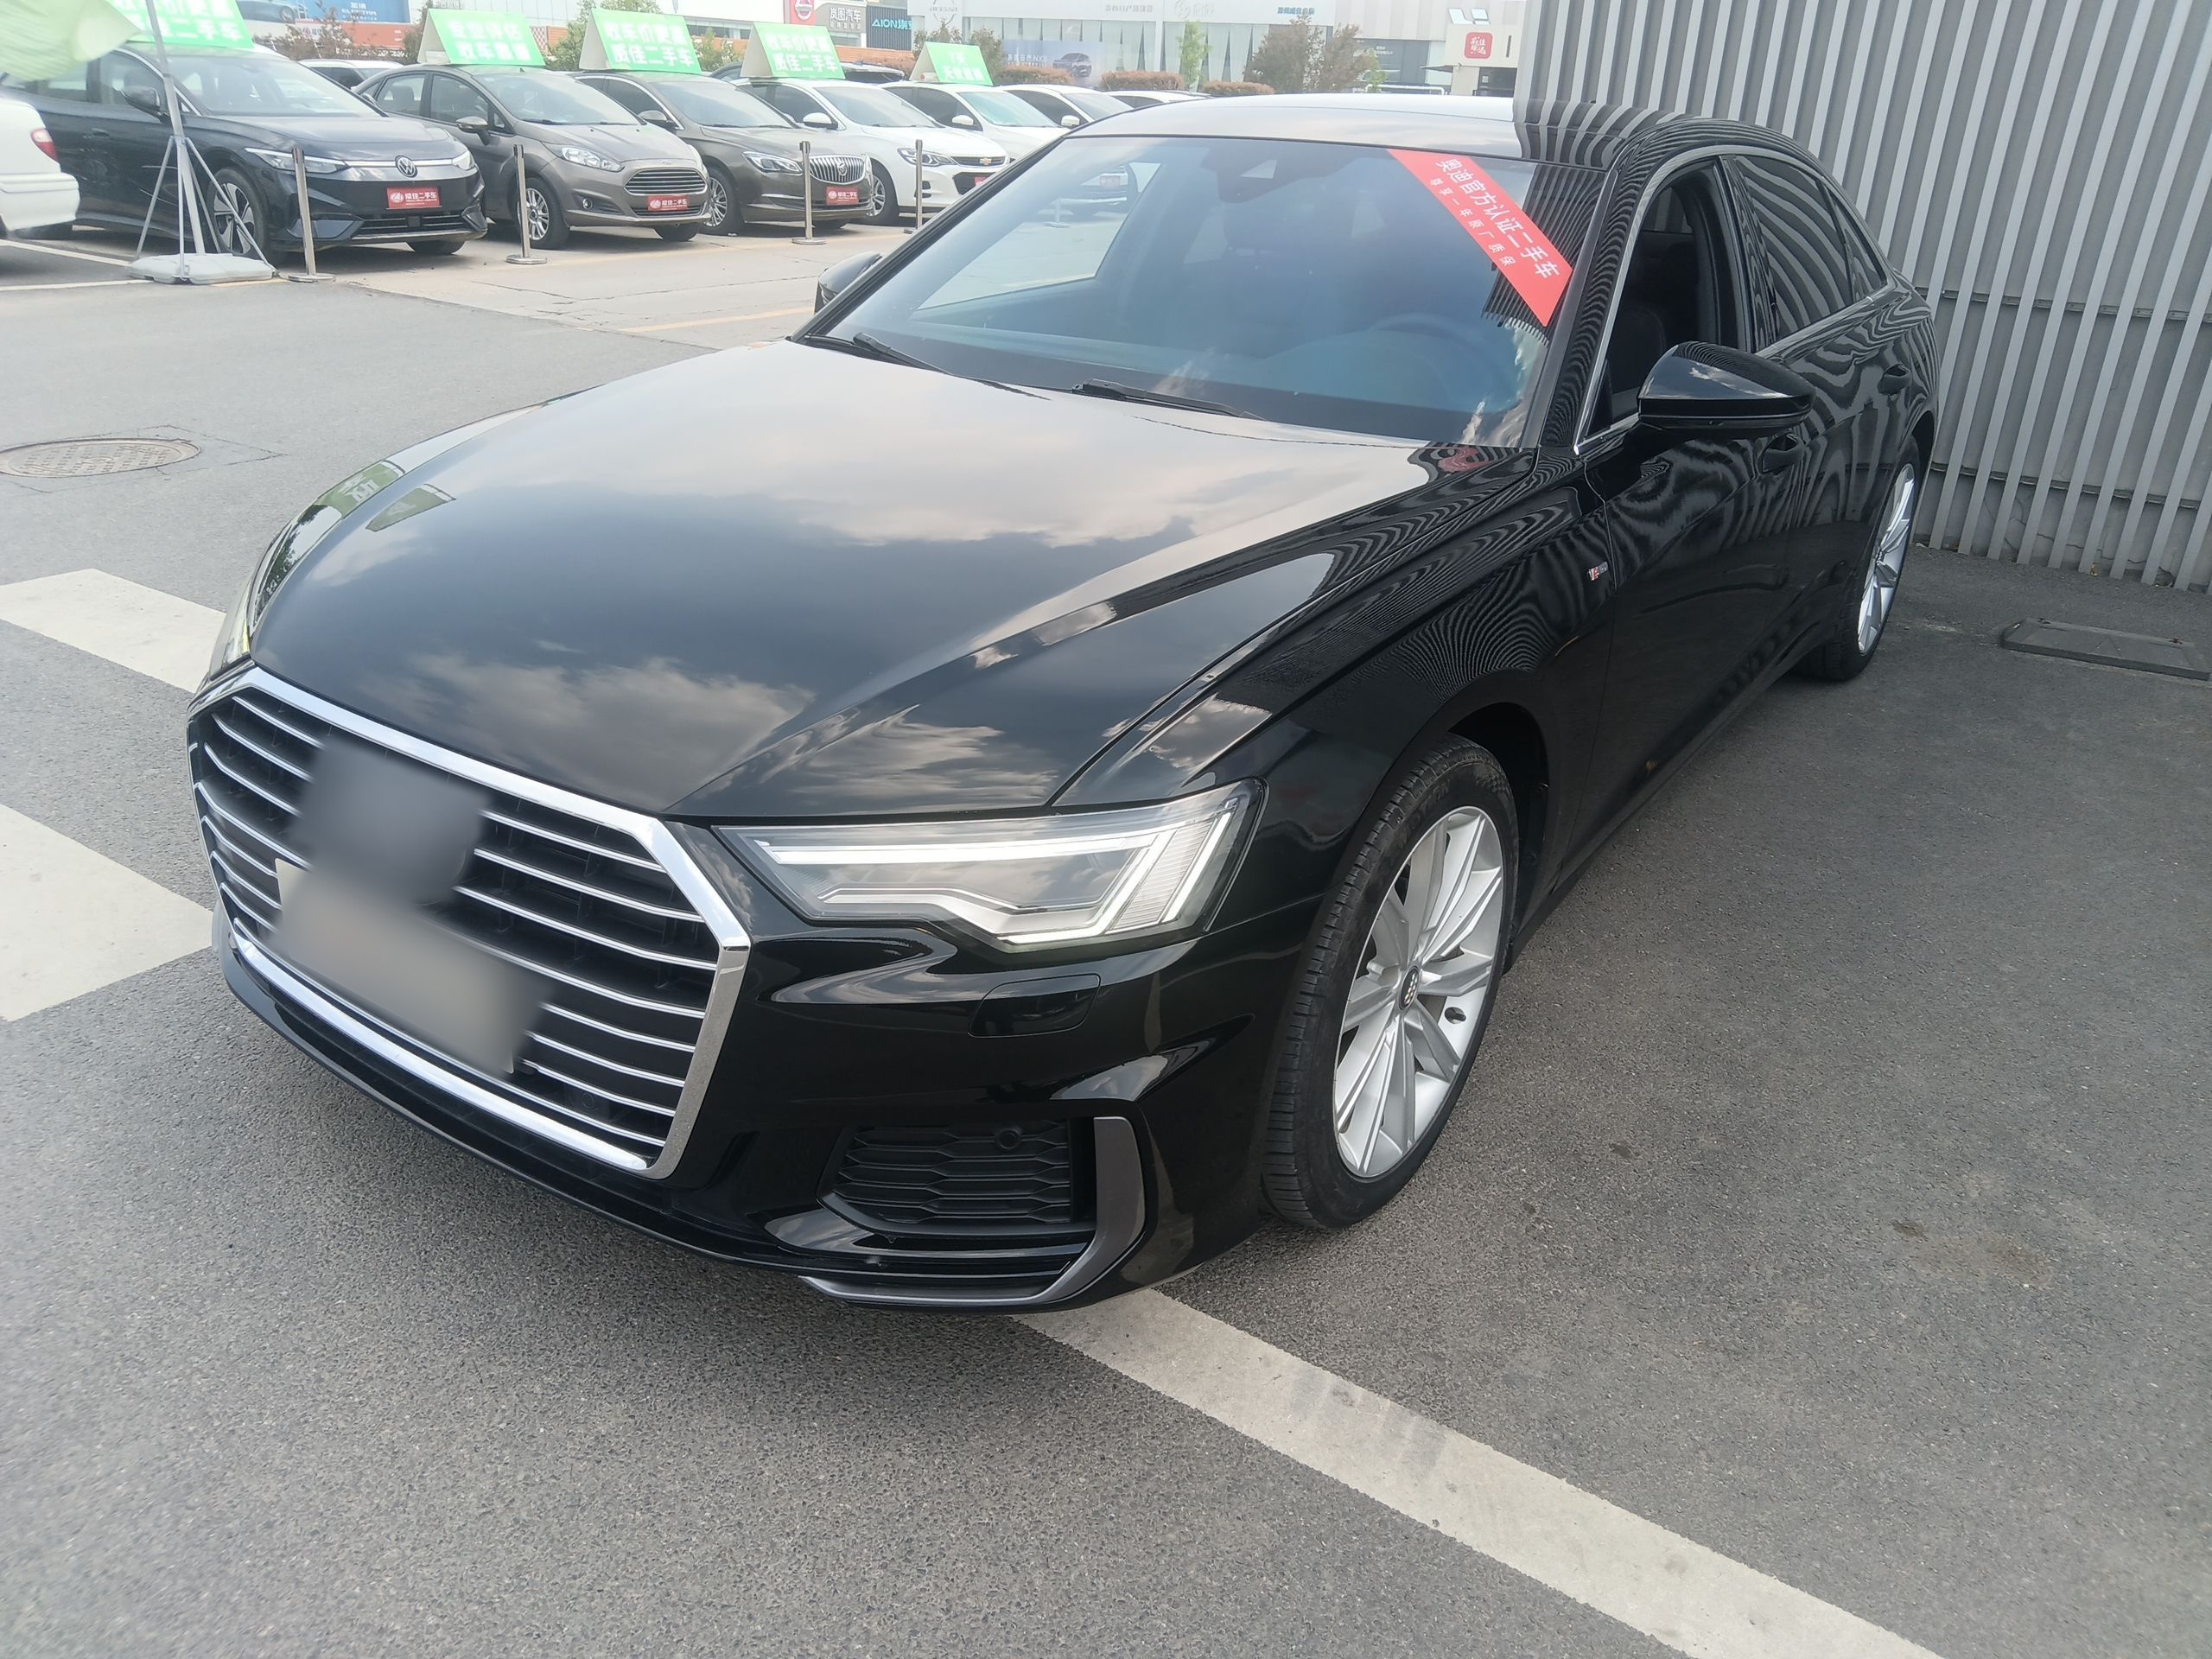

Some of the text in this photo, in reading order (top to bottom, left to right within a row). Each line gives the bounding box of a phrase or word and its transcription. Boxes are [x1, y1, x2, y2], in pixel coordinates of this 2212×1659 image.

[830, 7, 861, 22] 岚图汽车
[1430, 177, 1516, 266] 尊享一年原厂质保
[1435, 158, 1560, 278] 奥迪官方认证二手车
